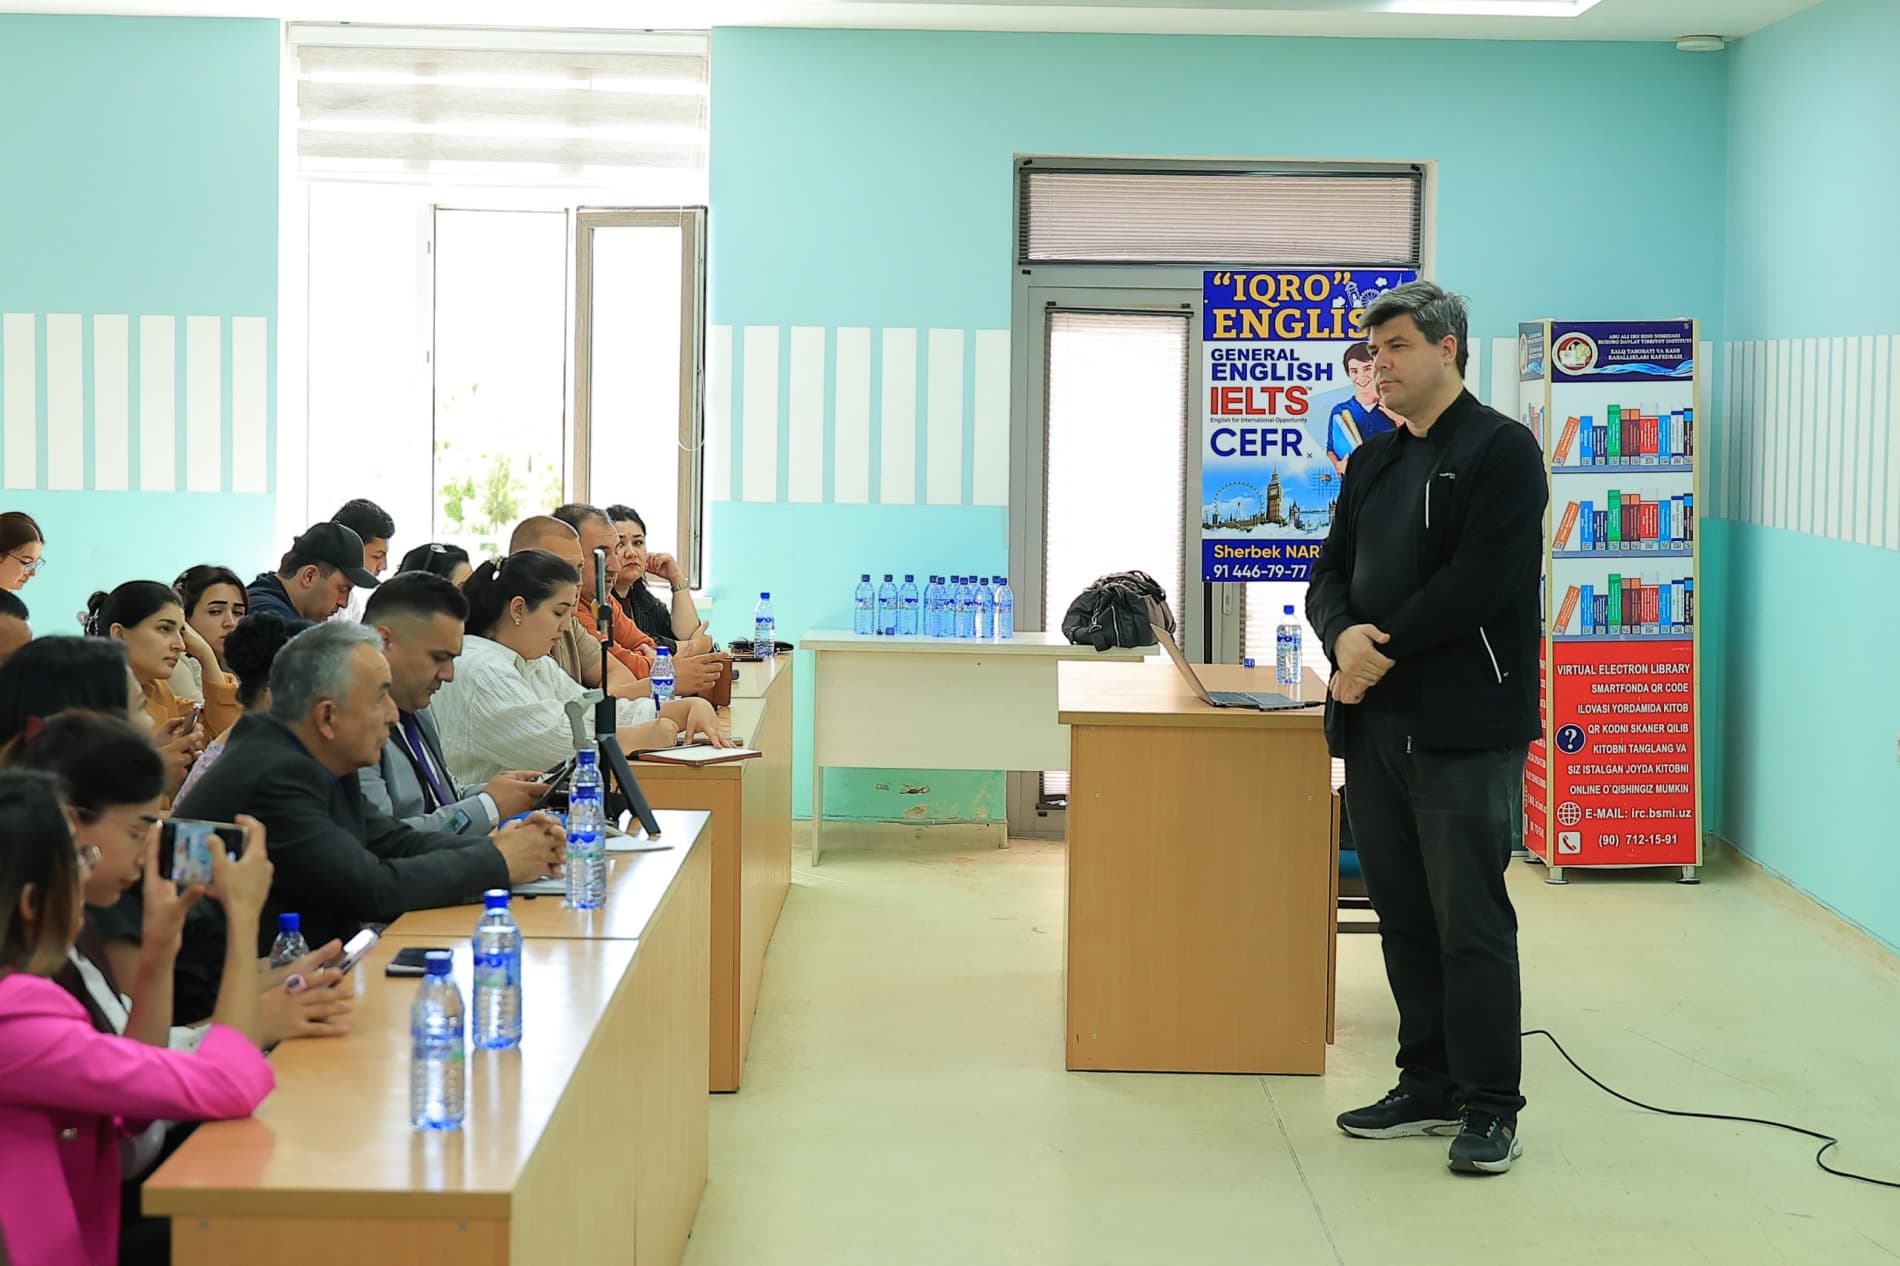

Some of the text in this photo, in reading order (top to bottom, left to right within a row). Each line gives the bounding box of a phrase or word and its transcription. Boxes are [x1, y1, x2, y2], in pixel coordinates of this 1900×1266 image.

[1213, 308, 1369, 339] ENGLIS
[1211, 349, 1299, 361] GENERAL
[1211, 363, 1333, 381] ENGLISH
[1210, 428, 1302, 457] CEFR
[1214, 545, 1322, 558] Sherbek NAR
[1213, 564, 1307, 578] 91 446-79-77
[1557, 664, 1690, 675] VIRTUAL ELECTRON LIBRARY
[1592, 683, 1689, 693] SMARTFONDA QR CODE
[1578, 703, 1688, 713] ILOVASI YORDAMIDA KITOB
[1588, 724, 1688, 734] QR KODNI SKANER QILIB
[1593, 744, 1687, 753] KITOBNI TANGLANG VA
[1568, 764, 1689, 774] SIZ ISTALGAN JOYDA KITOBNI
[1570, 785, 1600, 794] ONLINE
[1656, 784, 1689, 793] MUMKIN
[1586, 808, 1691, 818] E-MAIL: irc.bsmi.uz
[1599, 834, 1677, 846] (90) 712-15-91
